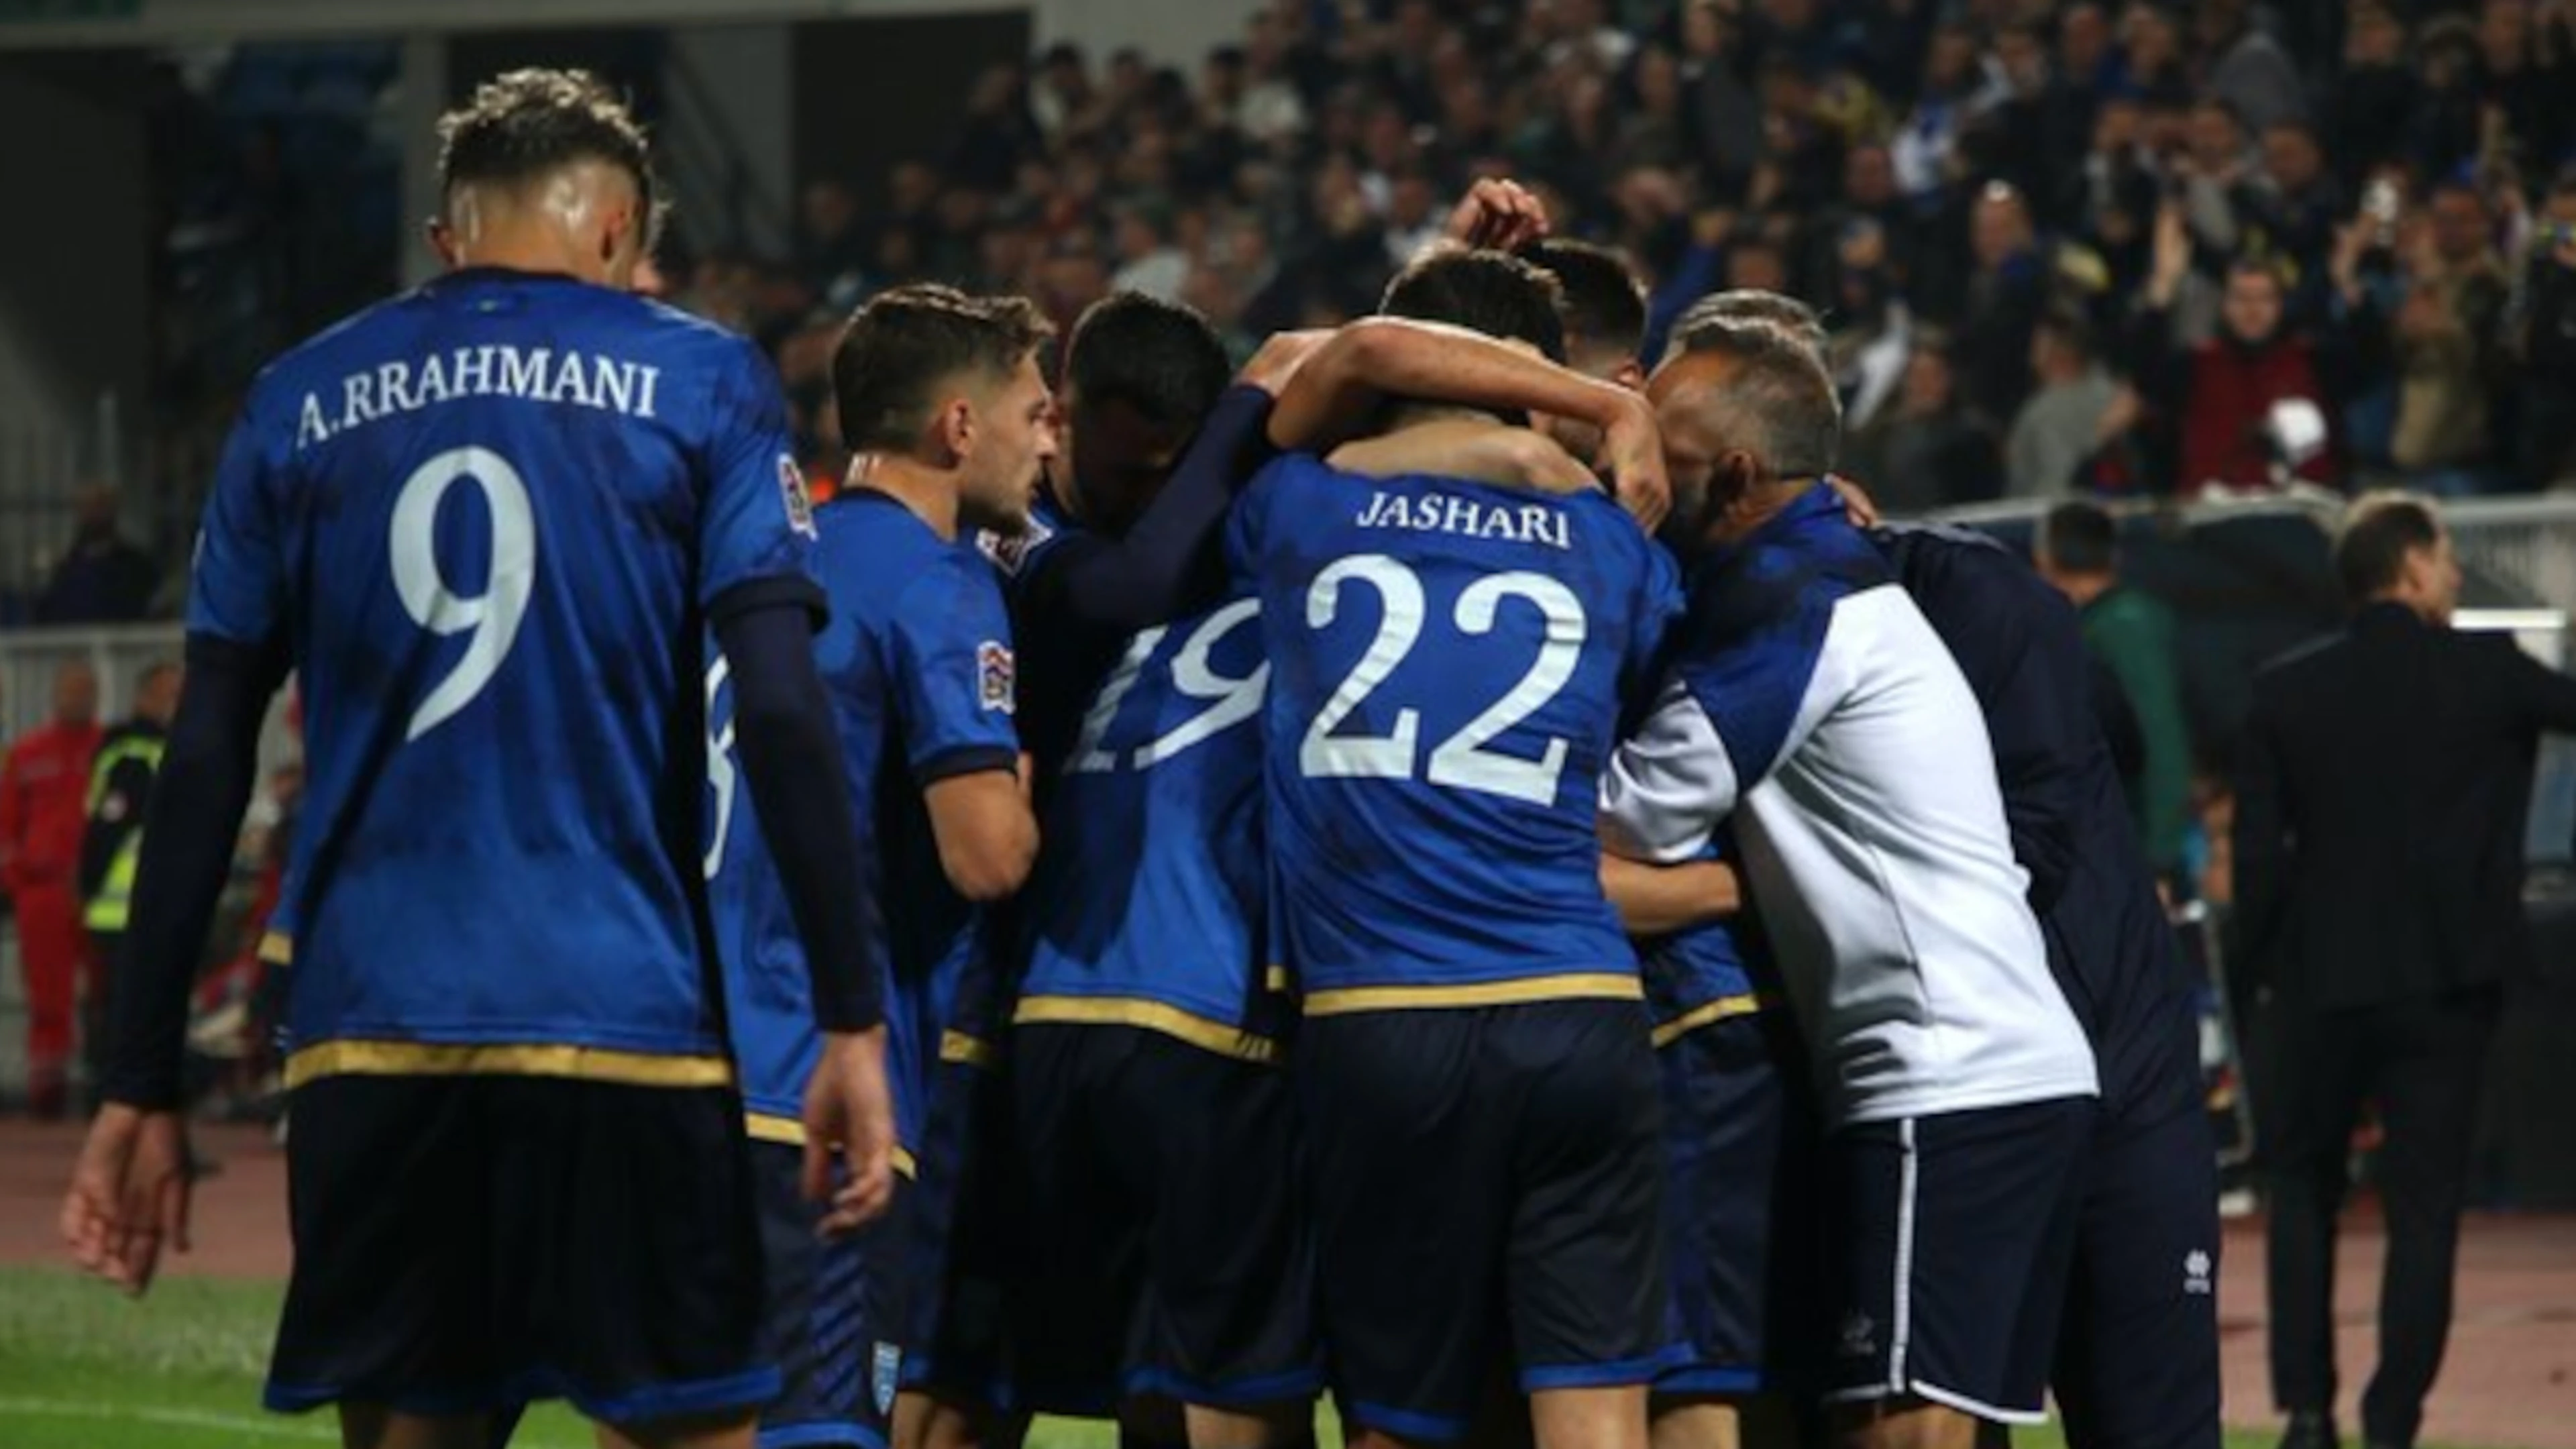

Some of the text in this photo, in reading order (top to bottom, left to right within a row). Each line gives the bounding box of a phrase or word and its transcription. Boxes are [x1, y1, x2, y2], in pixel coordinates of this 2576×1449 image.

[297, 344, 660, 449] A.RRAHMANI
[390, 444, 535, 743] 9
[1356, 491, 1572, 549] JASHARI
[1061, 597, 1271, 775] 19
[1299, 553, 1587, 807] 22
